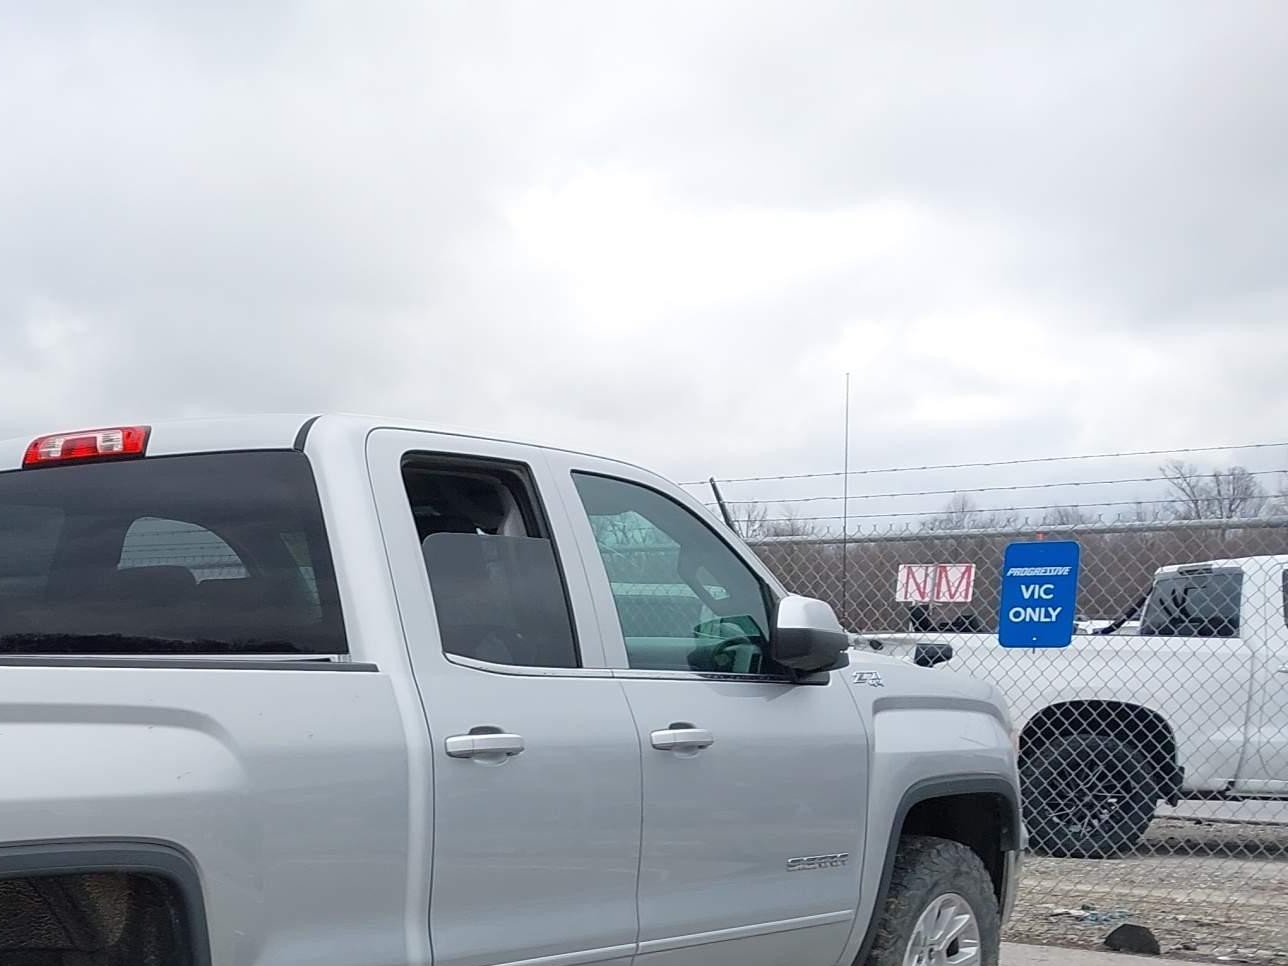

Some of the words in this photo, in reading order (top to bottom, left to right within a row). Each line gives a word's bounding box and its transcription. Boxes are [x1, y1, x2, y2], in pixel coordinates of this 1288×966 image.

[1006, 566, 1072, 577] PROGRESSIVE
[903, 563, 972, 600] NM
[1020, 583, 1055, 600] VIC
[1008, 606, 1062, 622] ONLY
